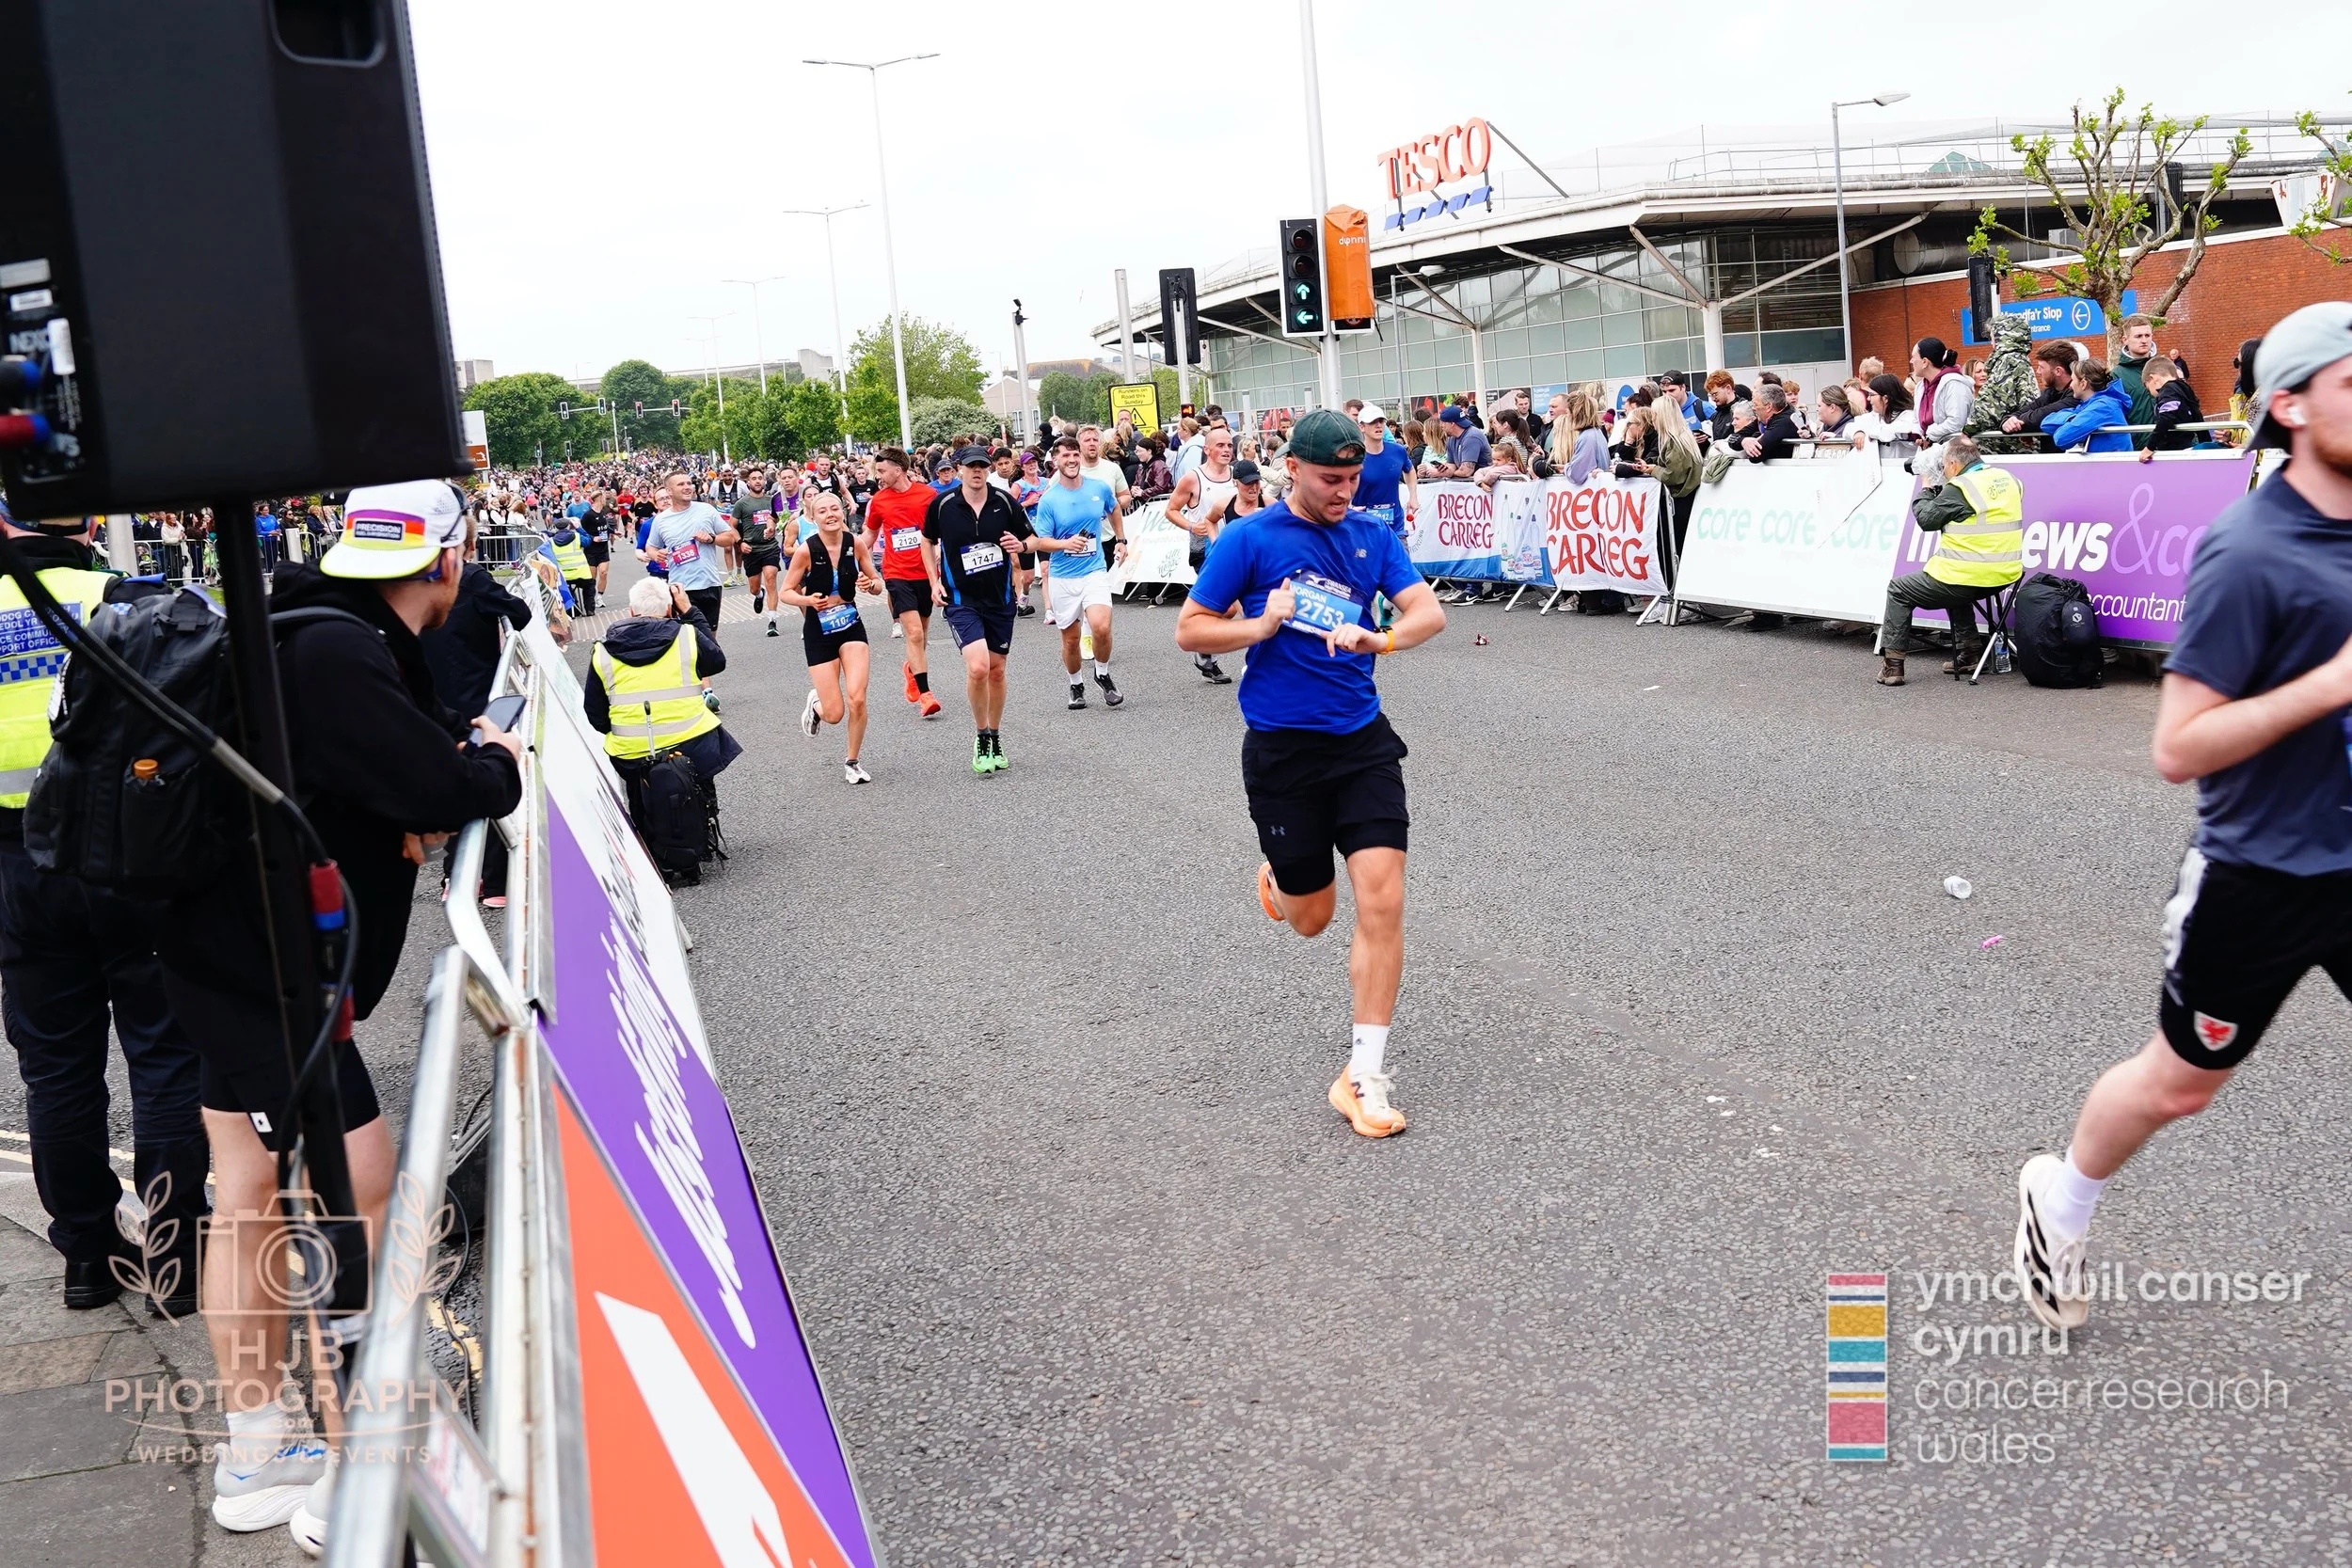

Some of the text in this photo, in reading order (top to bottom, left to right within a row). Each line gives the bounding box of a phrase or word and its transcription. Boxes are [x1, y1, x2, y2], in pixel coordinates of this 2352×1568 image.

[1377, 117, 1491, 201] TESCO
[2043, 307, 2062, 321] Siop
[2028, 325, 2051, 333] ntrance
[1438, 494, 1494, 521] BRECON
[1546, 487, 1646, 533] BRECON
[357, 523, 401, 533] PRECISION
[1697, 507, 1751, 541] core
[898, 536, 918, 546] 2120
[1438, 521, 1495, 549] CARREG
[677, 549, 695, 561] 1338
[972, 553, 994, 565] 1747
[1547, 533, 1649, 580] CARREG
[1296, 599, 1344, 628] 2753
[2088, 592, 2188, 623] ccountant
[830, 614, 850, 628] 1107
[0, 641, 25, 653] PORT
